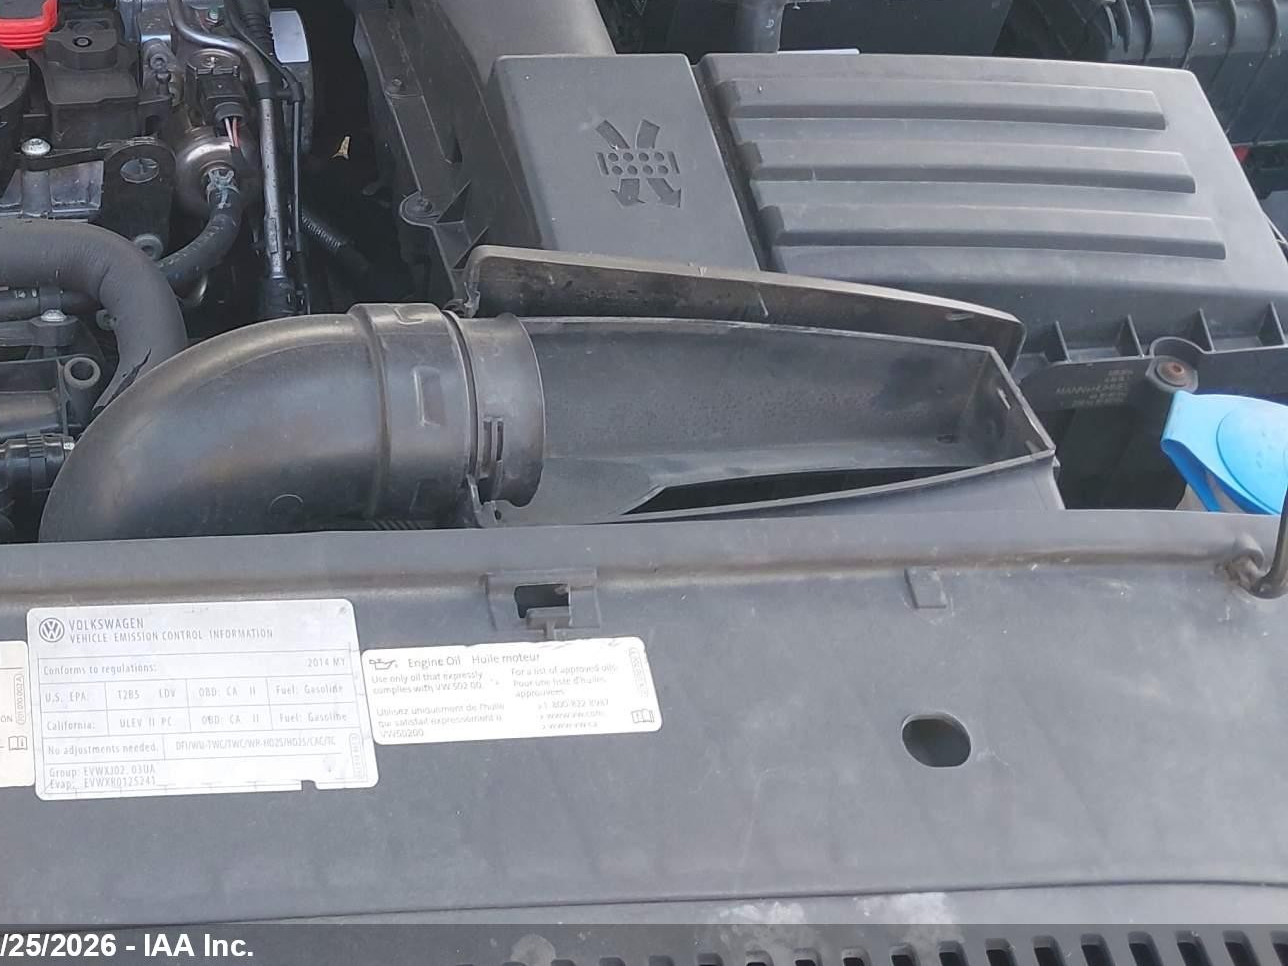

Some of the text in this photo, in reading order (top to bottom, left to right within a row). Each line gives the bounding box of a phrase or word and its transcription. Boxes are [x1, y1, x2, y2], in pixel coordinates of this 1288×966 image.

[69, 618, 144, 630] VOLKSWAGEN
[70, 629, 273, 643] VEHICLE EMISSION CONTROL INFORMATION
[44, 666, 86, 675] Conforms
[90, 665, 98, 673] to
[308, 658, 329, 667] 2014
[408, 652, 540, 669] Engine Oil Huile moteur
[304, 683, 343, 694] Gasoline
[47, 721, 95, 730] California:
[120, 718, 142, 728] ULEV
[308, 713, 348, 722] Gasoline
[48, 746, 60, 755] No
[64, 745, 119, 756] adjustments
